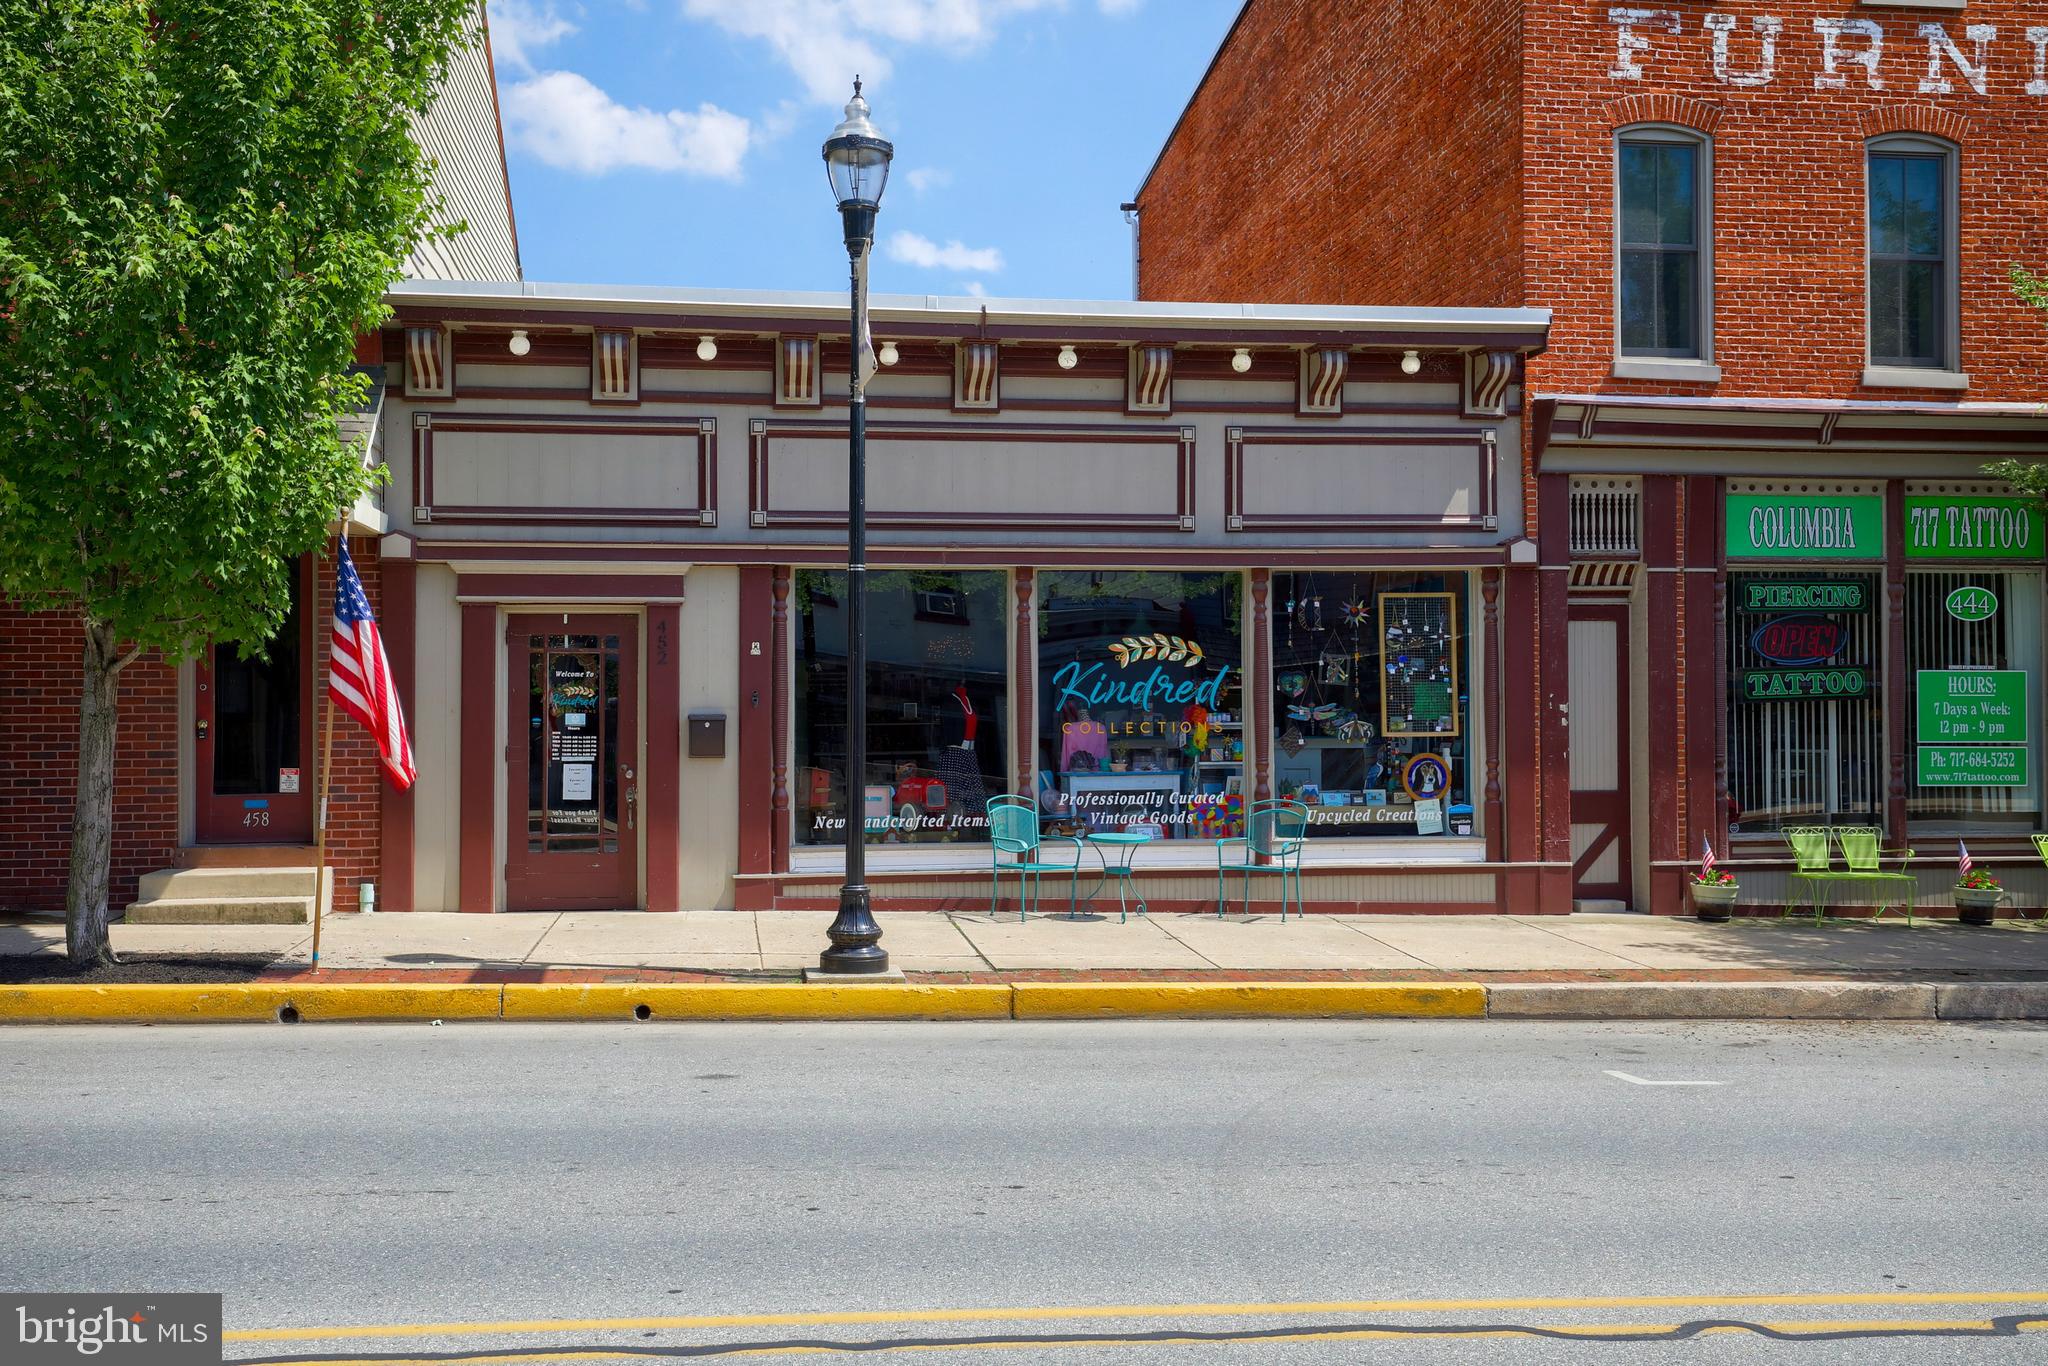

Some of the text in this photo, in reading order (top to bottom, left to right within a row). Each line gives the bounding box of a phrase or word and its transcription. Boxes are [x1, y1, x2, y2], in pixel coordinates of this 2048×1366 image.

[1749, 506, 1856, 549] COLUMBIA
[1911, 506, 2030, 549] 717 TATTOO
[1749, 585, 1861, 607] PIERCING
[1951, 591, 1990, 614] 444
[1763, 625, 1837, 656] OPEN
[1053, 661, 1229, 713] Kindred
[1748, 671, 1863, 695] TATTOO
[1948, 676, 1996, 694] HOURS:
[1934, 702, 2011, 718] 7 Days a Week:
[1062, 721, 1224, 735] COLLECTIONS
[1940, 720, 1950, 733] 12
[1953, 723, 1969, 736] pm
[1979, 720, 1985, 733] 9
[1989, 723, 2005, 736] pm
[1931, 751, 2015, 767] Ph: 717-684-5252
[1926, 771, 2020, 782] www.717tattoo.com
[1059, 791, 1225, 809] Professionally Curated
[243, 811, 270, 827] 458
[813, 814, 991, 831] New andcrafted Items
[1091, 811, 1194, 826] Vintage Goods
[1307, 809, 1370, 825] Upcycled
[1376, 808, 1442, 821] Creations
